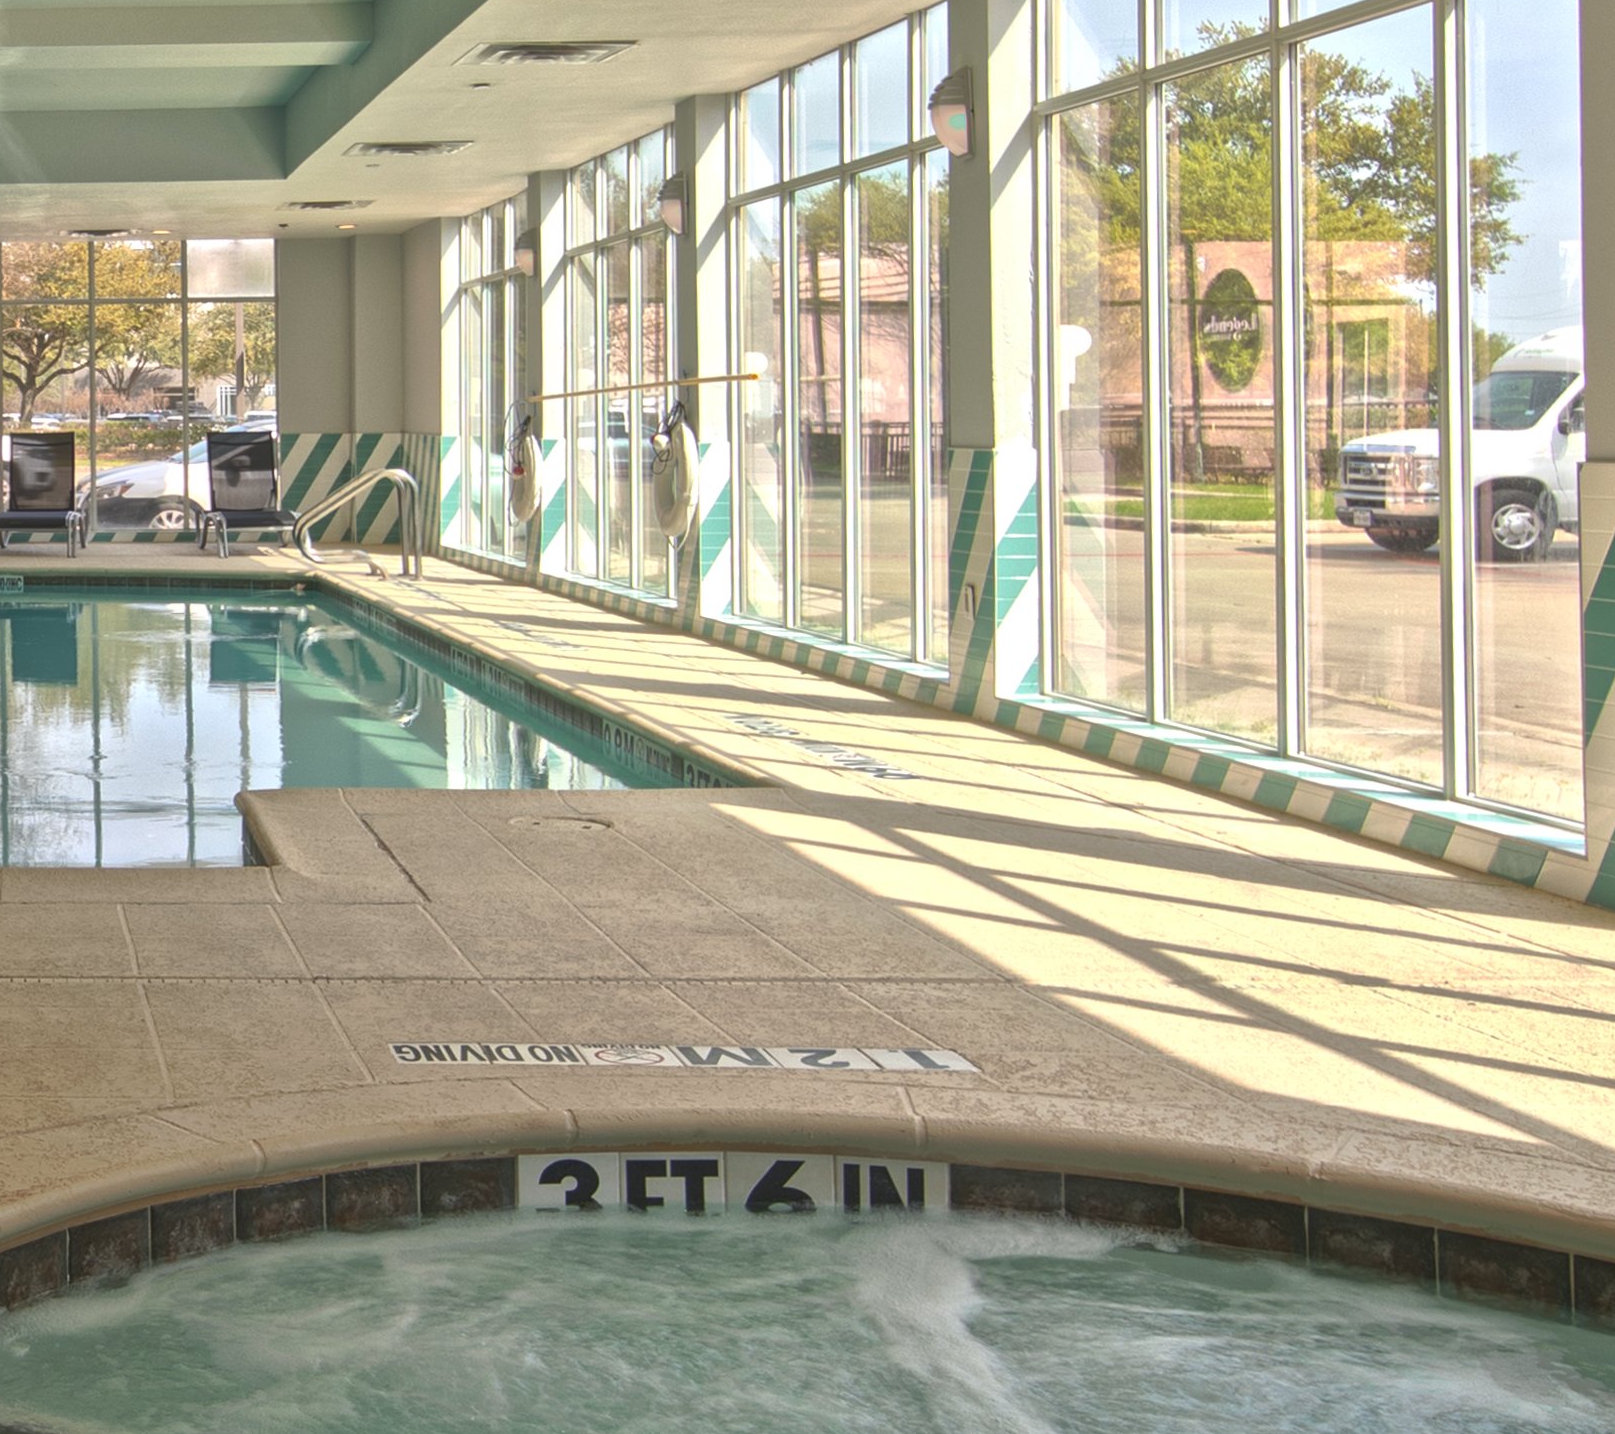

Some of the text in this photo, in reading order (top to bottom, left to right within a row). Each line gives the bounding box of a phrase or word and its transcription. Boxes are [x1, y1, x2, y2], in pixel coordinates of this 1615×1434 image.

[392, 1044, 525, 1063] DIVING
[527, 1045, 580, 1063] NO
[538, 1158, 925, 1213] 3 FT 6 IN
